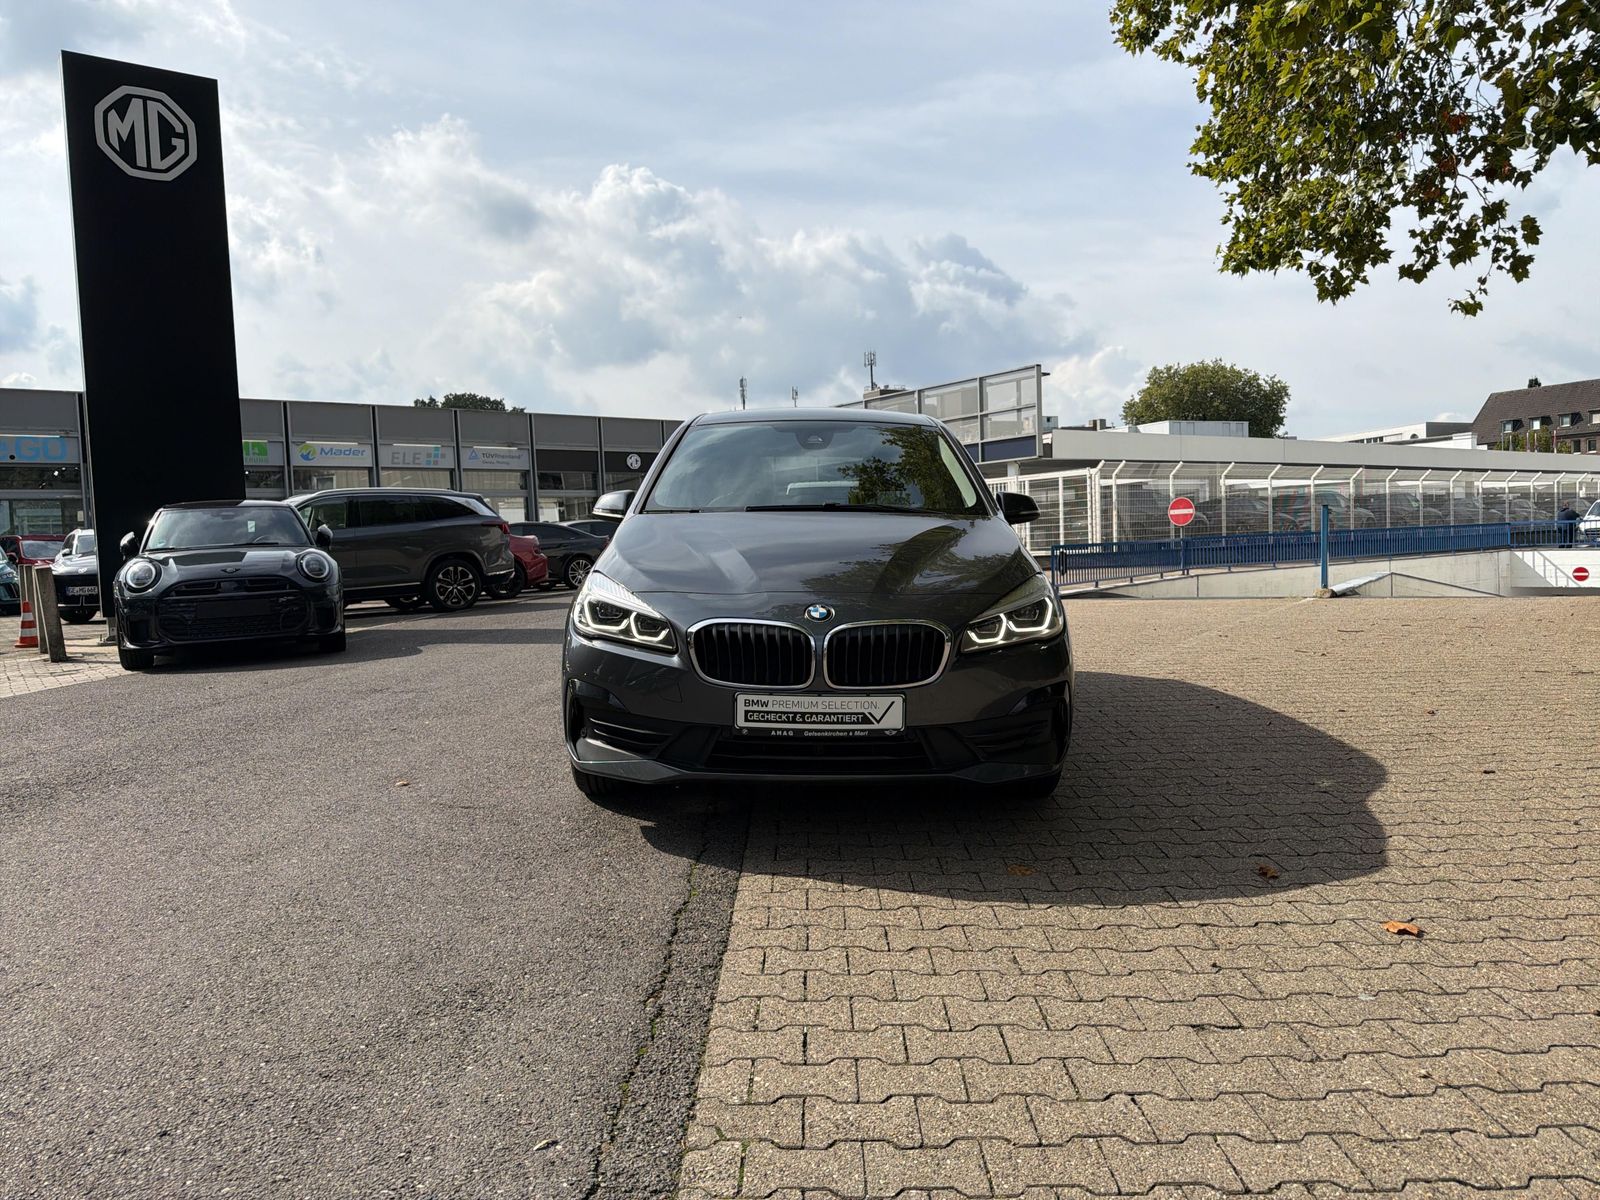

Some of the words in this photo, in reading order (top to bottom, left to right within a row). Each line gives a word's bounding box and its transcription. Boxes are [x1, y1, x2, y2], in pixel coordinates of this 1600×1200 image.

[107, 97, 185, 170] MG
[320, 447, 366, 457] Mader
[391, 452, 422, 465] ELE
[744, 698, 770, 708] BMW
[772, 699, 819, 710] PREMIUM
[747, 712, 793, 722] GECHECKT
[796, 713, 802, 722] &
[805, 713, 863, 723] GARANTIERT
